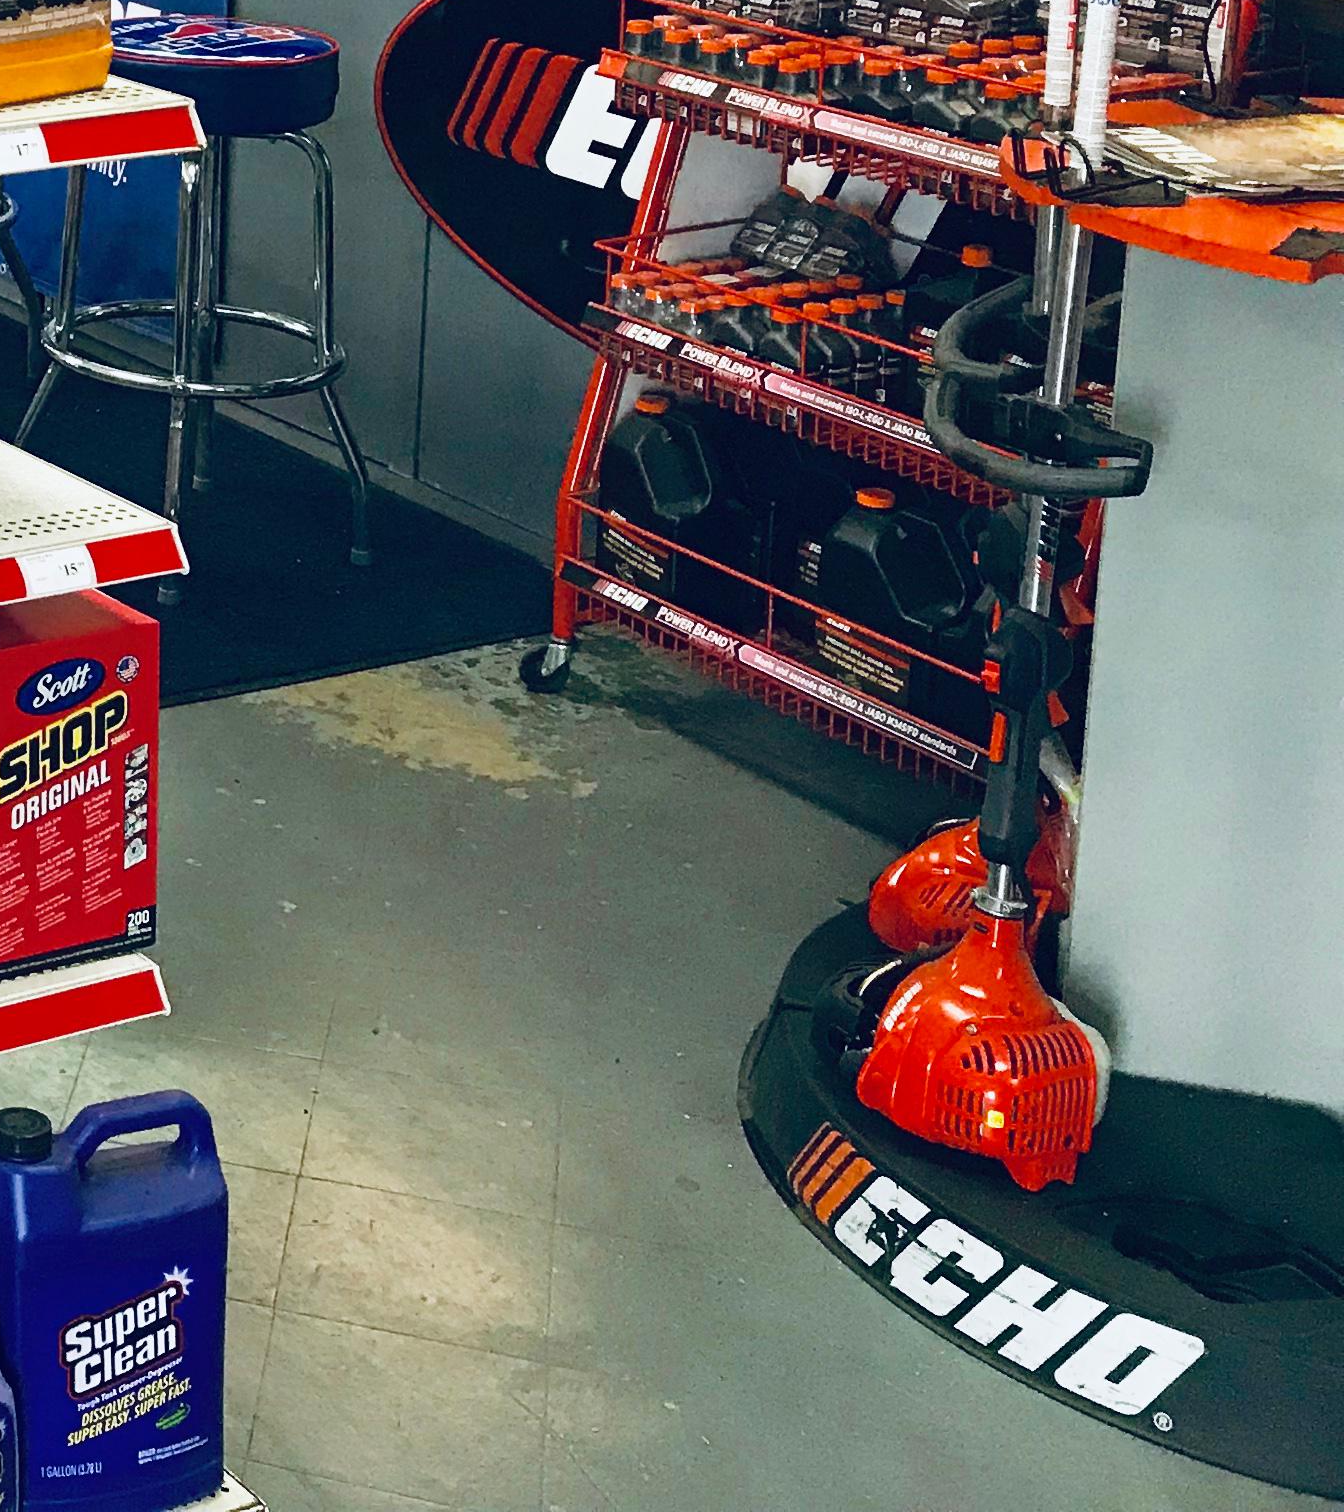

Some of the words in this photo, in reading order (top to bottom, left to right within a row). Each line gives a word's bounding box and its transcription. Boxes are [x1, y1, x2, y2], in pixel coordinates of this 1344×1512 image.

[672, 73, 719, 98] ECHO
[627, 322, 674, 351] ECHO
[602, 582, 649, 613] ECHO
[32, 662, 91, 710] Scott
[11, 759, 112, 830] ORIGINAL
[127, 909, 150, 927] 200
[833, 1174, 1207, 1417] ECHO
[64, 1286, 177, 1363] Super
[73, 1323, 177, 1396] Clean
[67, 1419, 104, 1448] SUPER
[105, 1409, 132, 1436] EASY.
[133, 1390, 167, 1419] SUPER
[167, 1377, 192, 1406] FAST.
[77, 1395, 100, 1412] Tough
[81, 1392, 136, 1427] DISSOLVES
[137, 1372, 177, 1402] GREASE.
[46, 1463, 77, 1479] GALLON
[78, 1462, 95, 1477] (3.78
